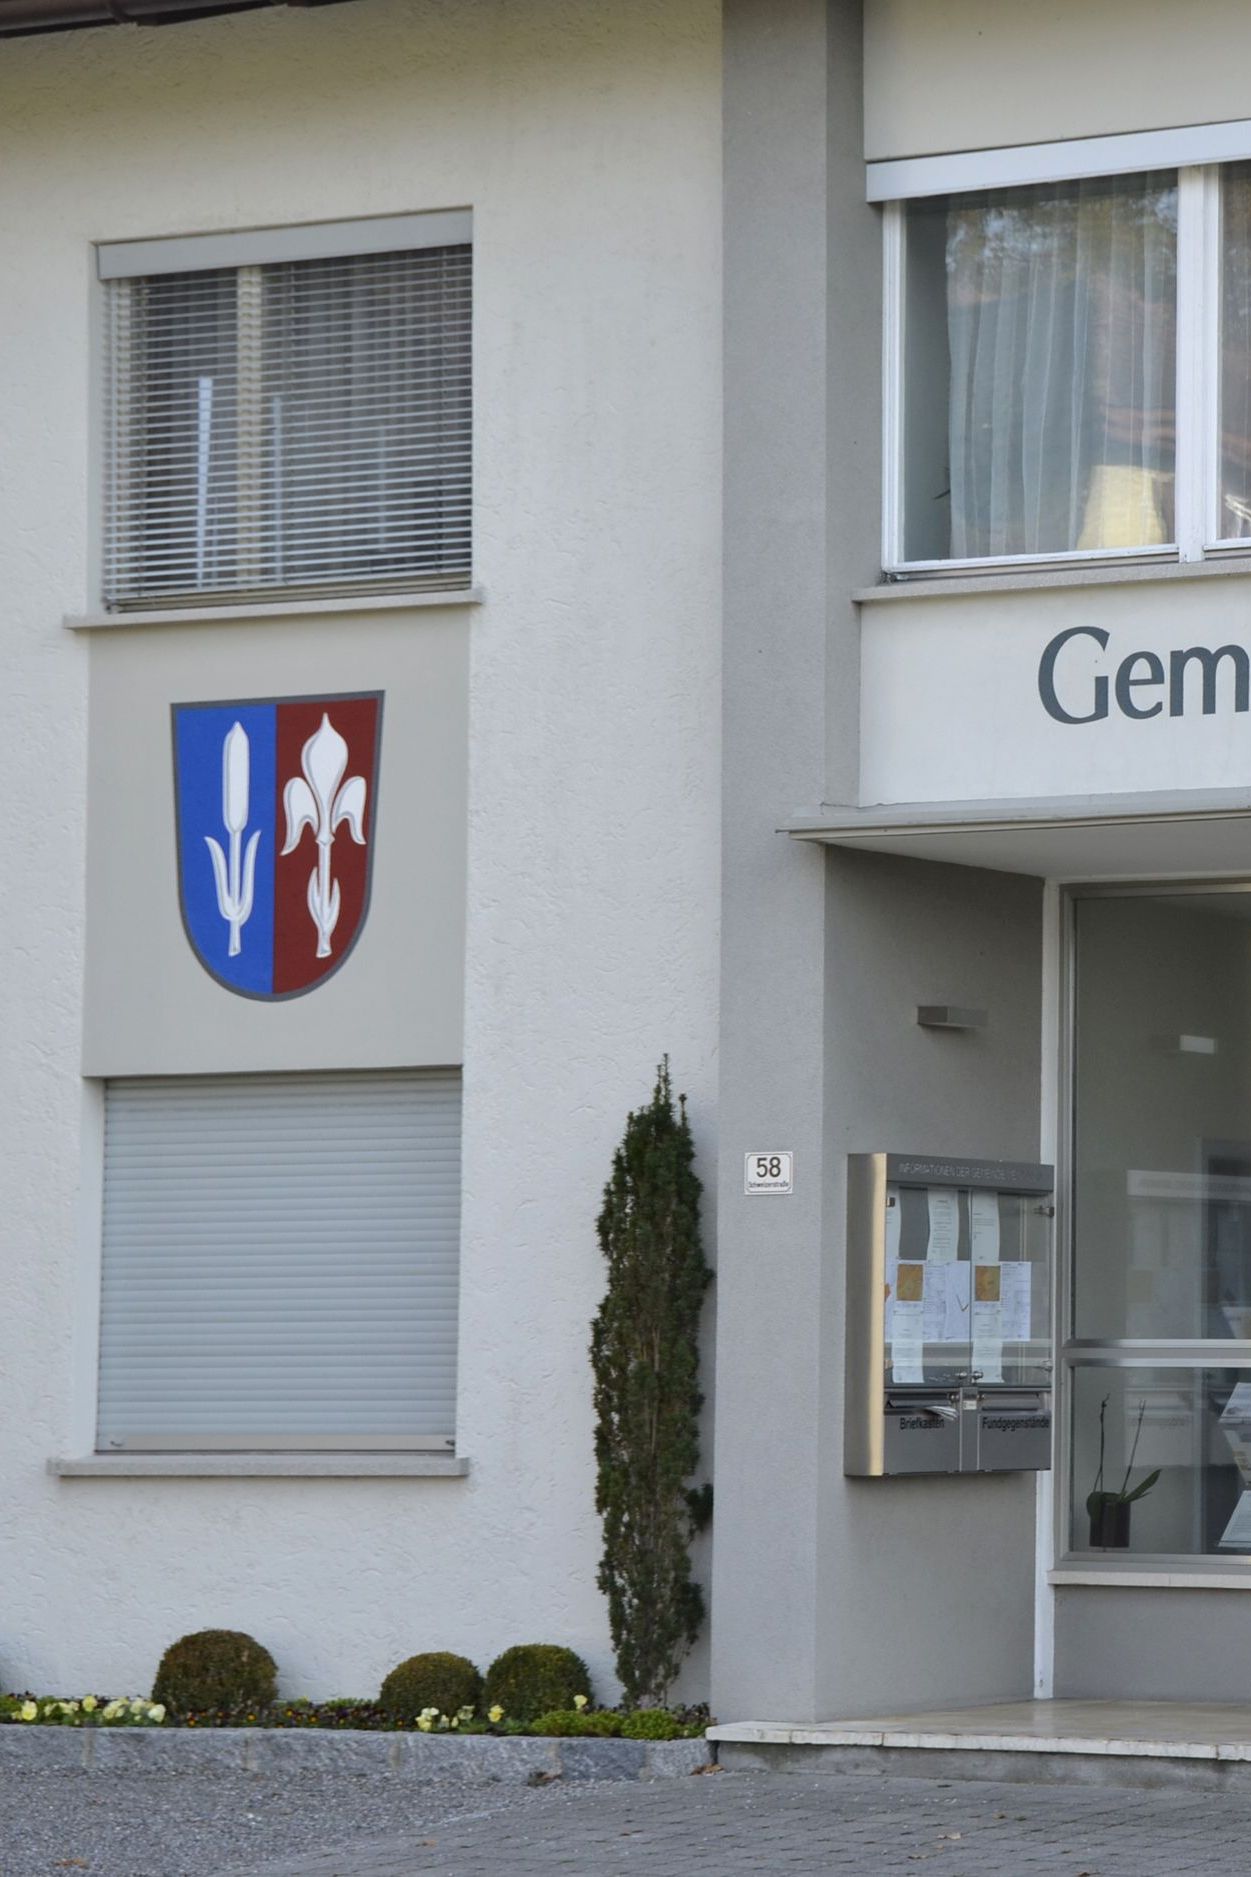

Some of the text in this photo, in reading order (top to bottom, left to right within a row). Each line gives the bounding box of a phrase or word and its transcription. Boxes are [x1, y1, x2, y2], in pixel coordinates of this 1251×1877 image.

[756, 1156, 781, 1178] 58
[900, 1417, 945, 1430] Briefkasten
[982, 1417, 1050, 1432] Fundgegenstände
